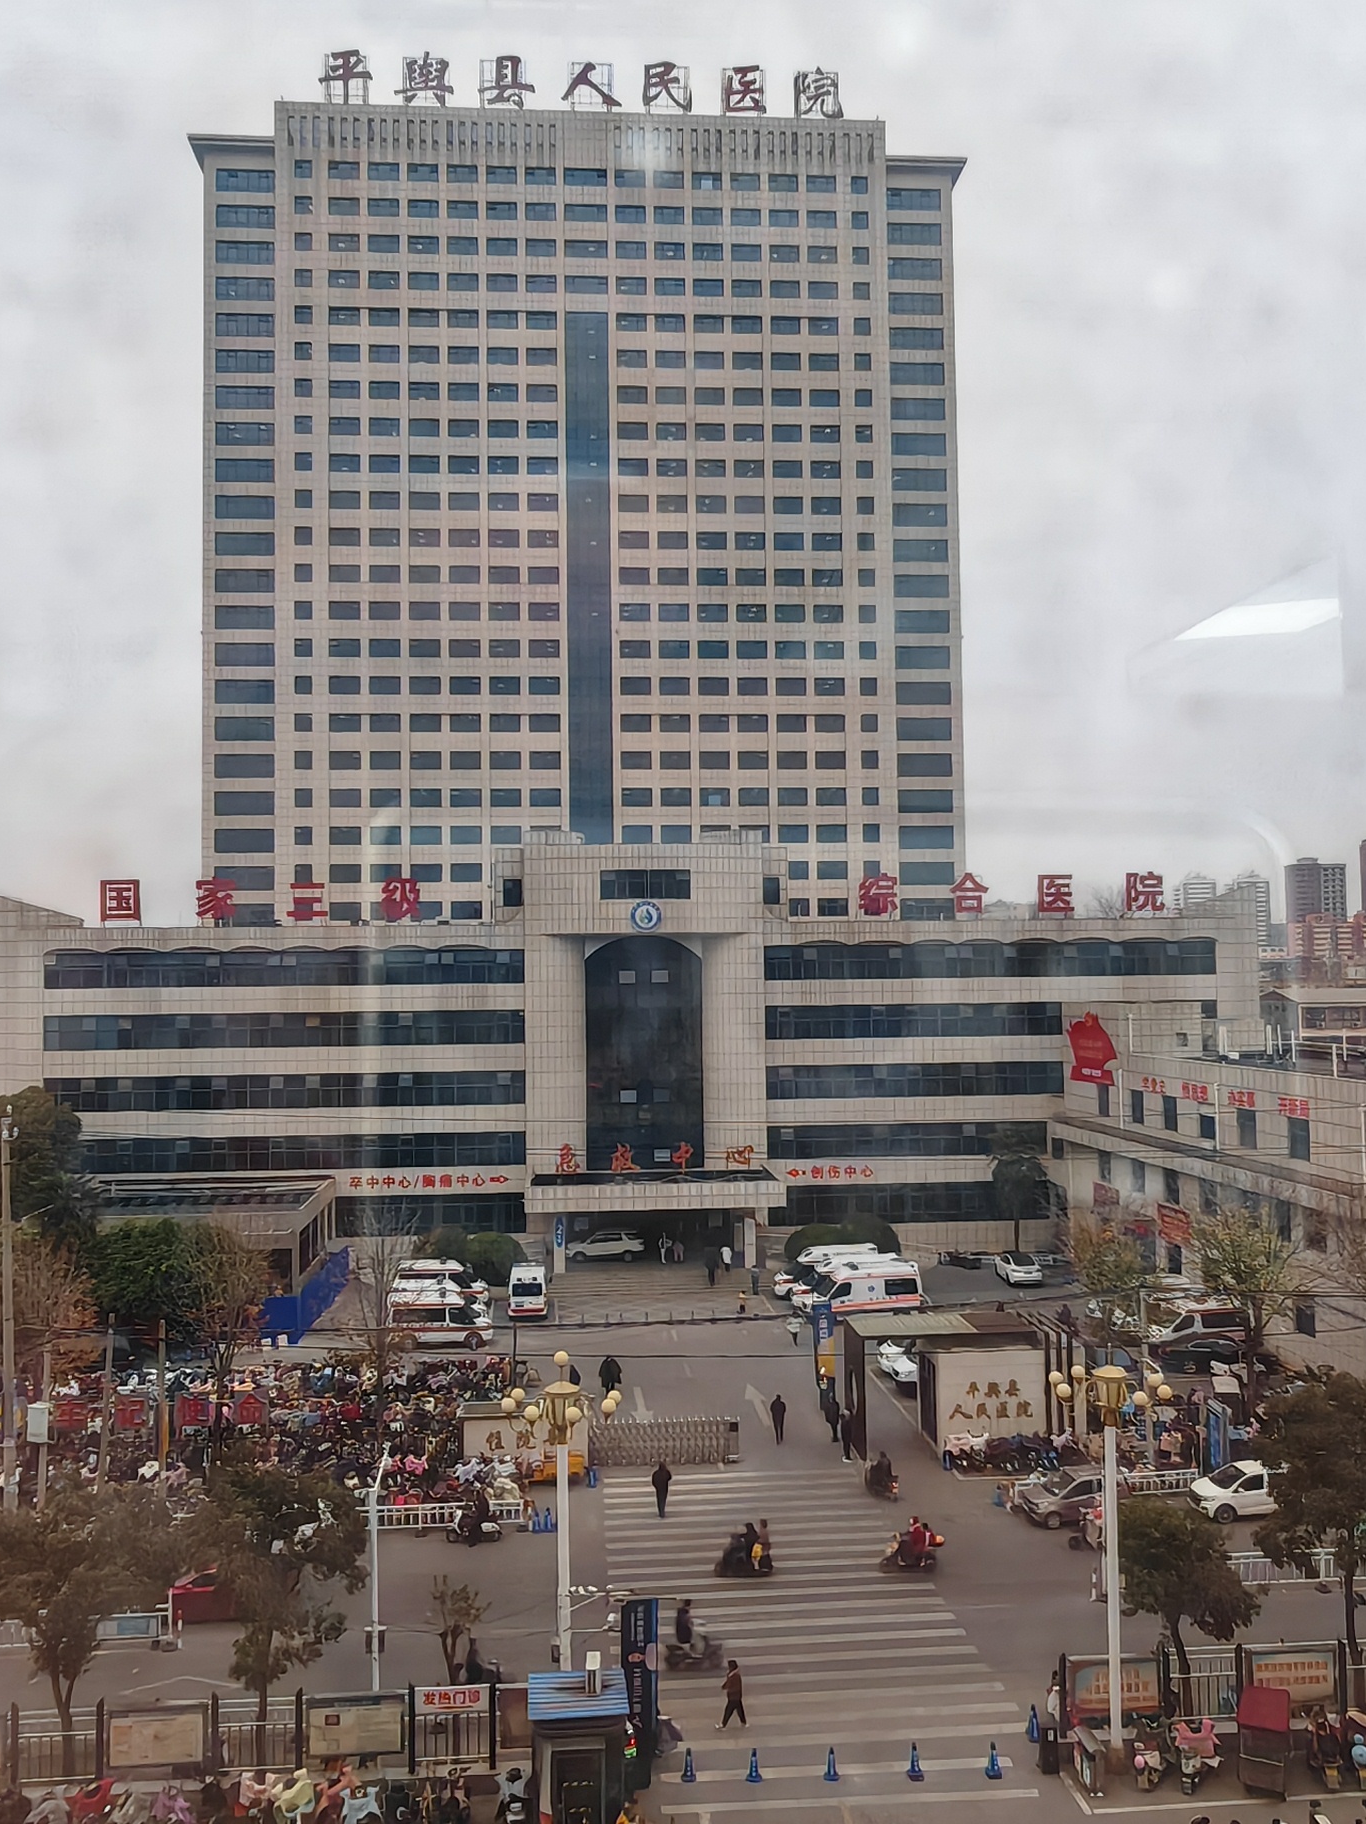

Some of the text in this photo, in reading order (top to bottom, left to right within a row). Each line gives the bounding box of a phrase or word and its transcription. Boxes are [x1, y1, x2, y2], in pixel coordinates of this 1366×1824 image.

[318, 49, 844, 119] 平舆县人民医院
[100, 871, 1166, 922] 国家三级 综合医院
[555, 1140, 754, 1174] 急救中心
[810, 1165, 874, 1180] 创伤中心
[349, 1173, 486, 1190] 卒中中心/胸痛中心
